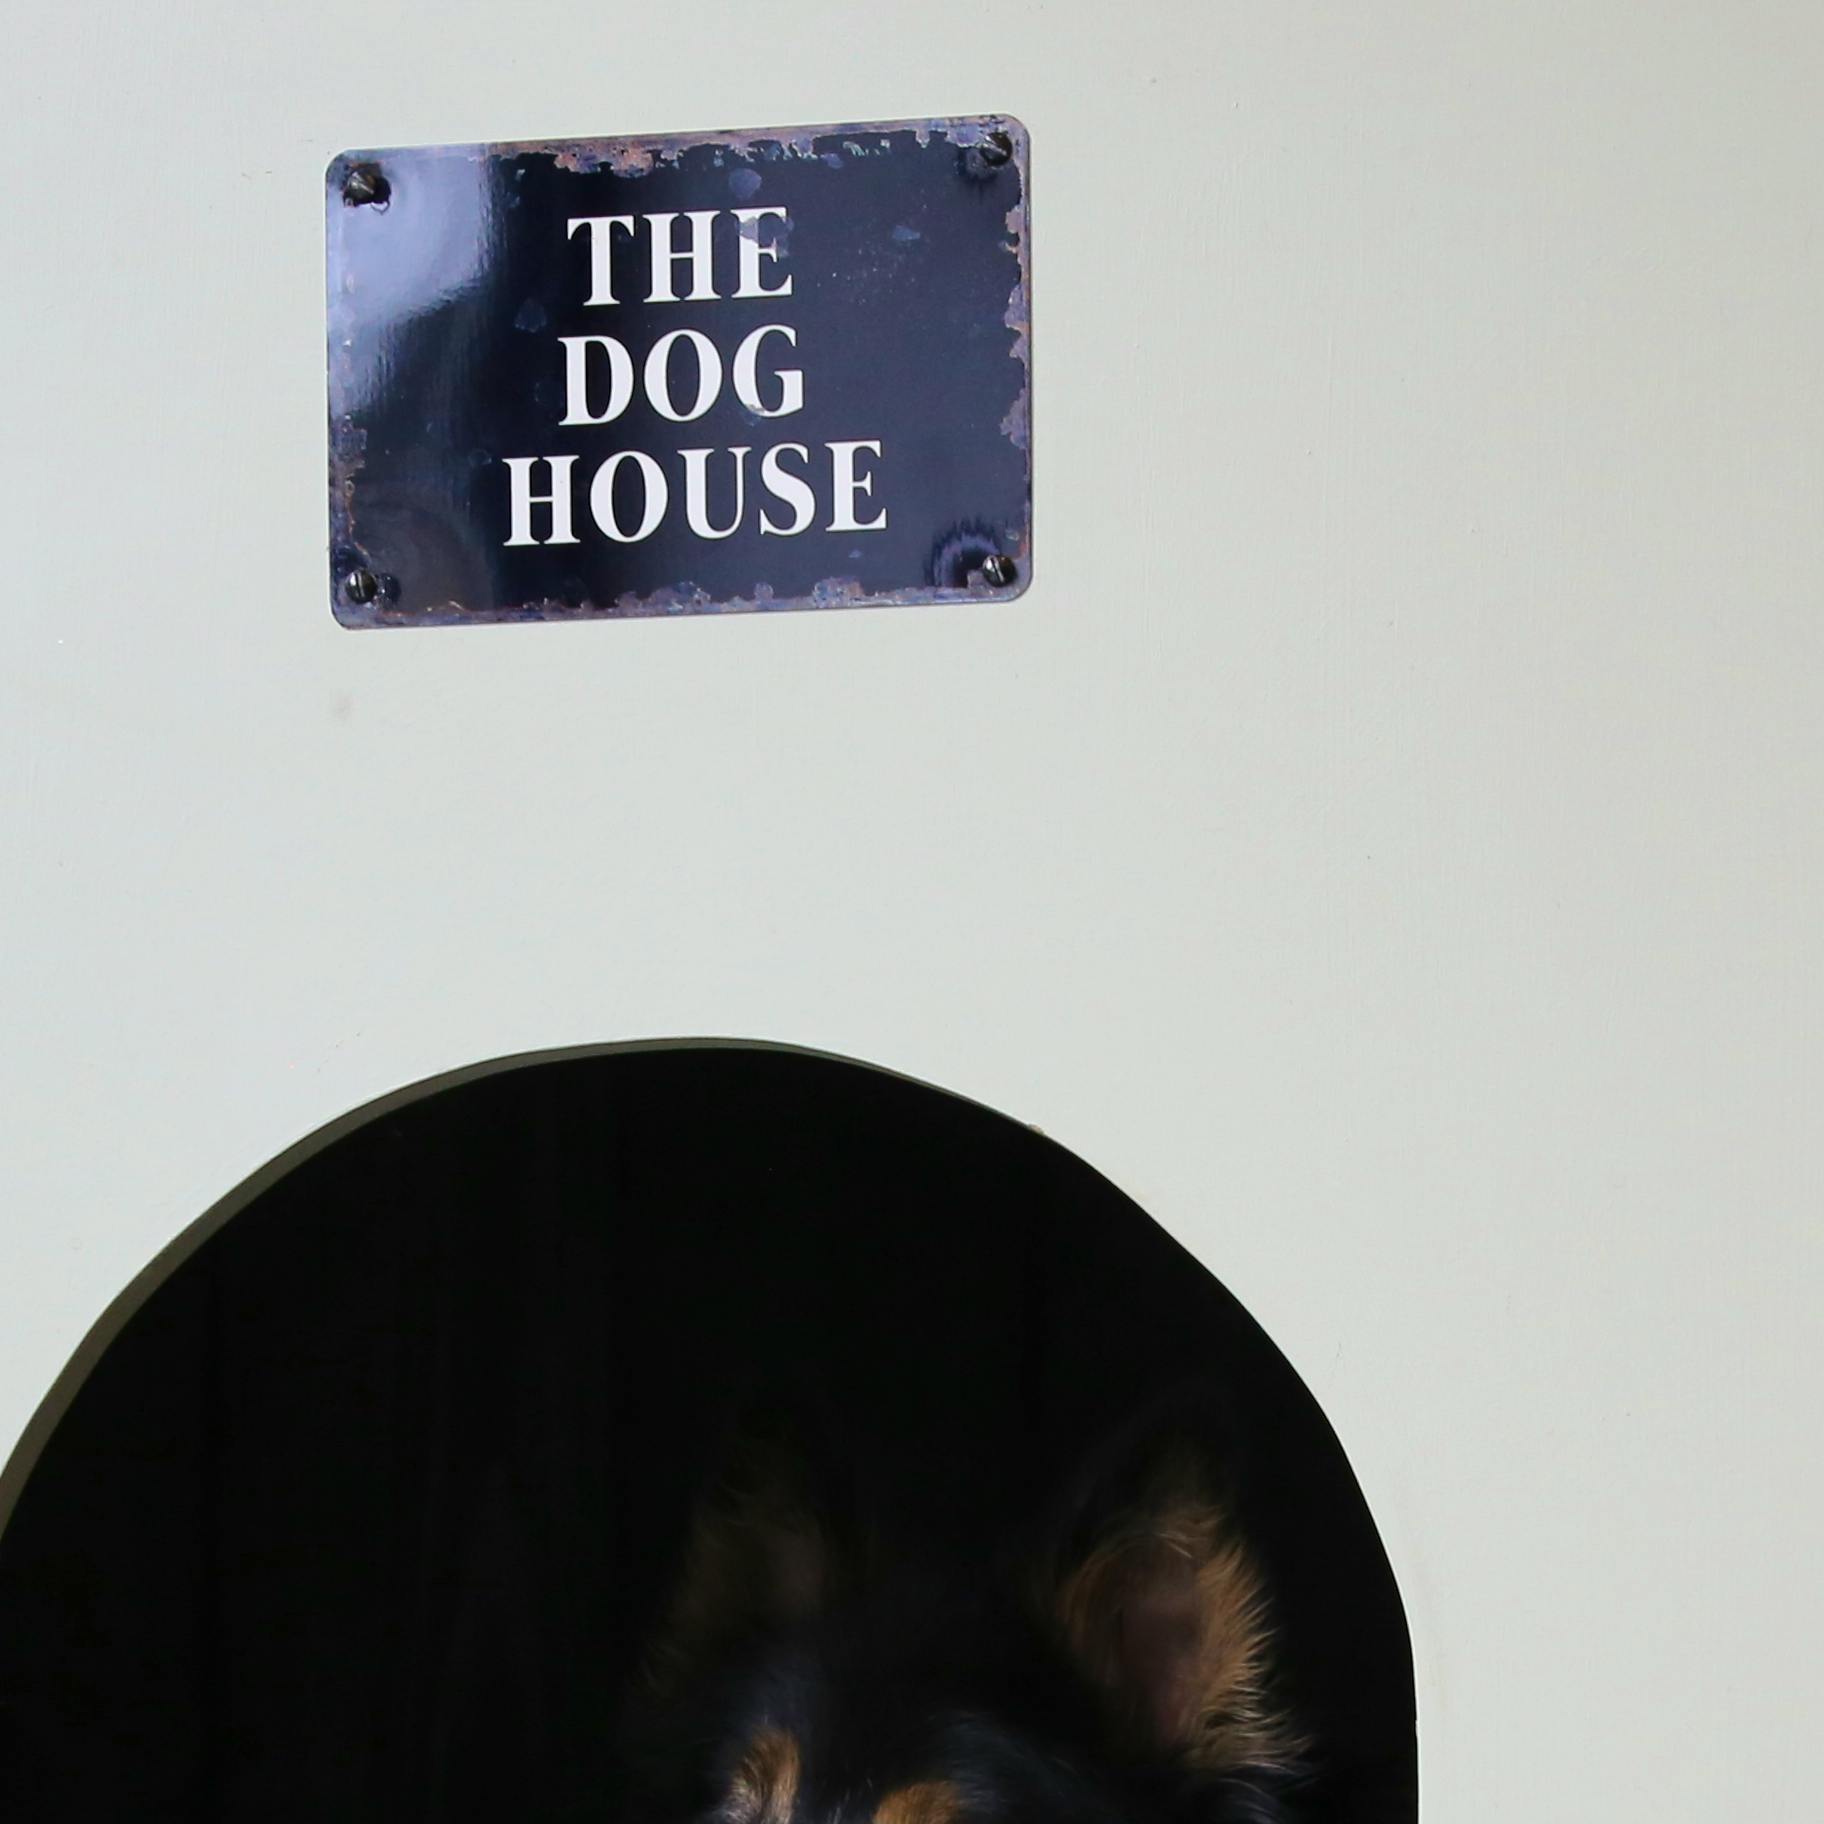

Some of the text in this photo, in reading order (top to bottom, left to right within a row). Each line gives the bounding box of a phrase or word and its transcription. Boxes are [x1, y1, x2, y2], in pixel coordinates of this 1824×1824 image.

[567, 206, 794, 306] THE
[557, 324, 806, 427] DOG
[502, 440, 888, 547] HOUSE
